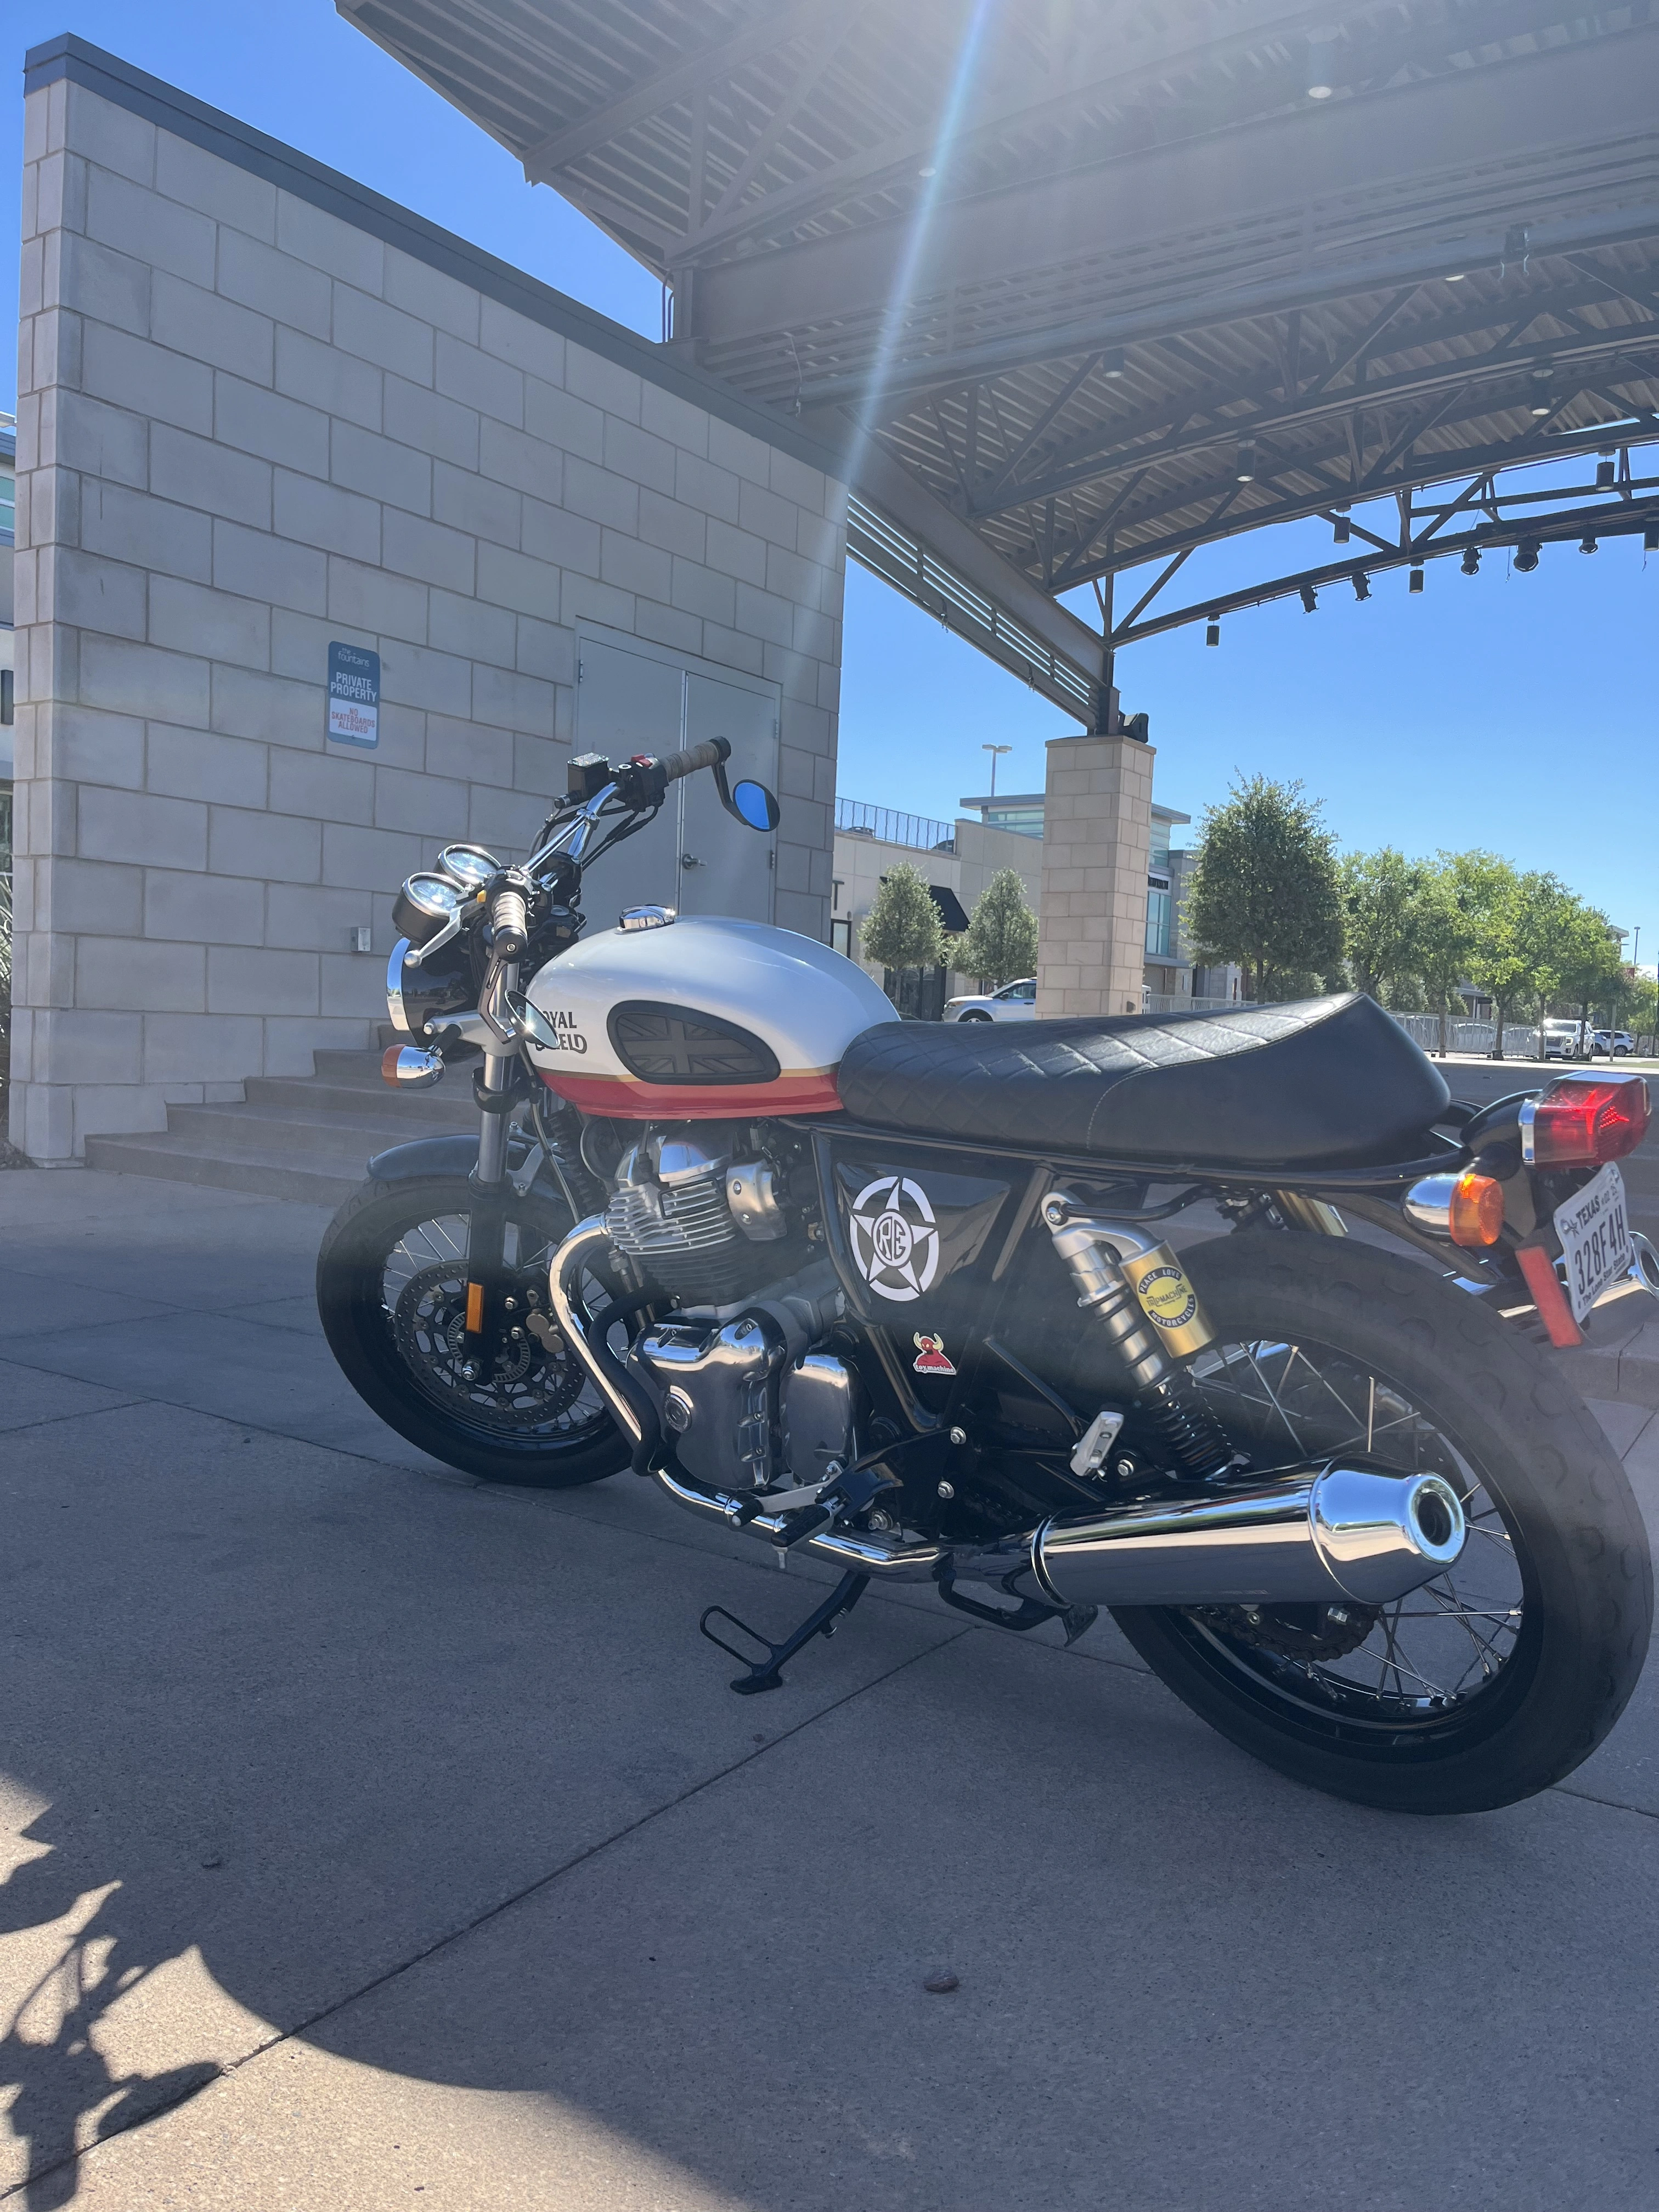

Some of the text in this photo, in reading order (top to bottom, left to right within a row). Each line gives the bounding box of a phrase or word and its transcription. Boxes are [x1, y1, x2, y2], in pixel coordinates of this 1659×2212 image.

[338, 651, 370, 667] fountains
[336, 672, 372, 690] PRIVATE
[330, 681, 377, 702] PROPERTY
[331, 712, 375, 728] SKATEBOARDS
[349, 708, 358, 716] NO
[338, 721, 368, 733] ALLOWED
[1576, 1195, 1600, 1229] TEXAS
[1575, 1204, 1626, 1295] 328F4H
[1139, 1268, 1180, 1293] PEACE LOVE
[1582, 1292, 1592, 1306] The
[1591, 1278, 1603, 1295] Lone
[1603, 1266, 1613, 1281] Star
[1613, 1253, 1626, 1270] State
[1150, 1297, 1194, 1327] MOTORCYCLES
[927, 1365, 954, 1373] machine
